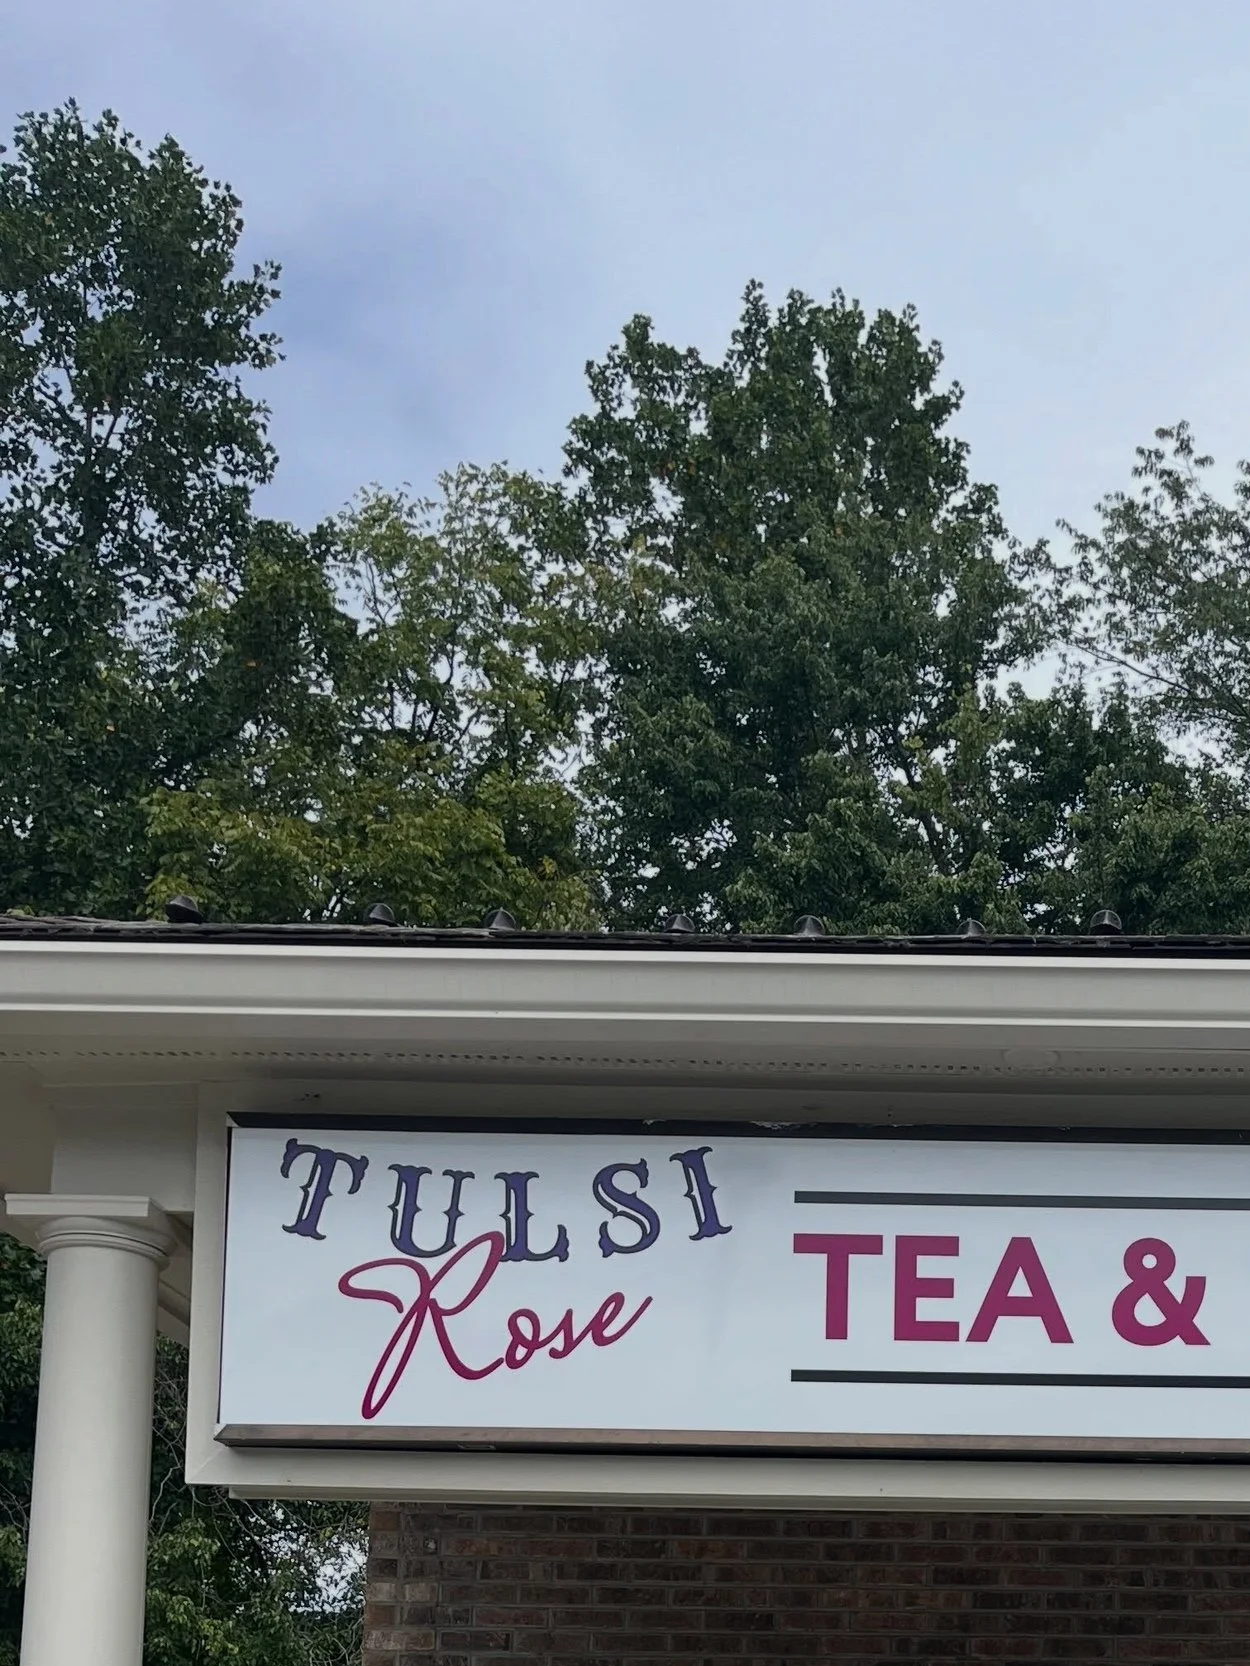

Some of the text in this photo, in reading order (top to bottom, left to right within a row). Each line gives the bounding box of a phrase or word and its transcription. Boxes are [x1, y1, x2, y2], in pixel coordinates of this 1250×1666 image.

[280, 1138, 732, 1262] TULSI
[338, 1231, 653, 1419] Rose
[793, 1233, 1073, 1344] TEA
[1111, 1237, 1211, 1347] &
